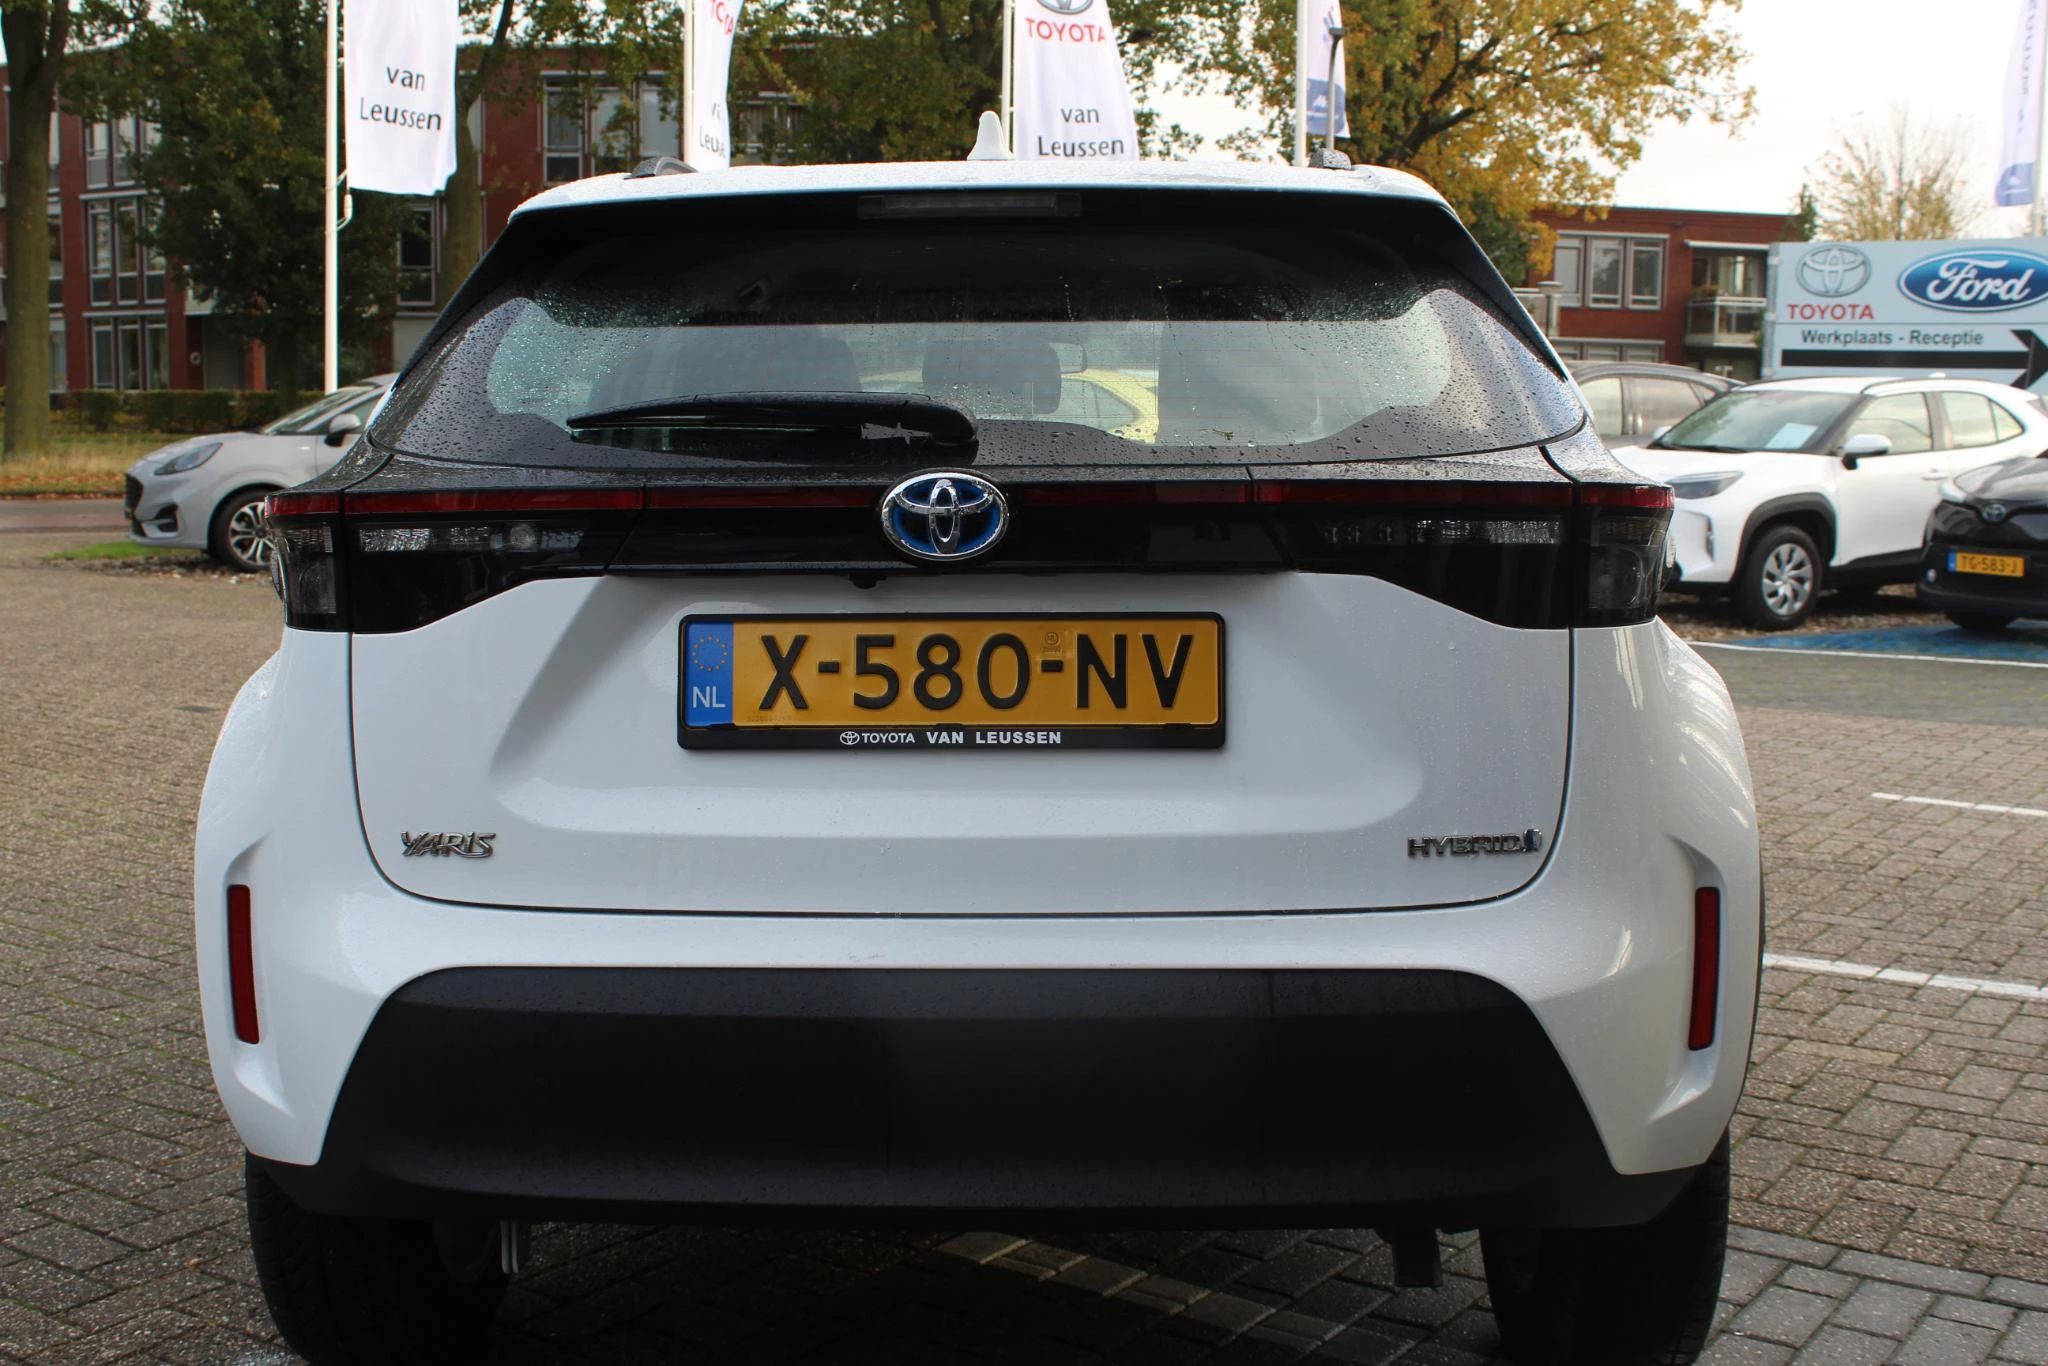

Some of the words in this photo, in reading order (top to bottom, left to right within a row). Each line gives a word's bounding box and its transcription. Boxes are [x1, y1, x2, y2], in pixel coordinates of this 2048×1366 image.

[386, 66, 425, 91] van
[360, 96, 442, 130] Leussen
[1061, 108, 1099, 123] van
[1038, 135, 1124, 157] Leussen
[1926, 258, 2036, 301] Ford
[1787, 303, 1875, 321] TOYOTA
[1801, 329, 1893, 349] Werkplaats
[1908, 329, 1984, 349] Receptie
[758, 633, 1194, 711] X-580-NV
[692, 686, 726, 709] NL
[861, 732, 916, 744] TOYOTA
[926, 731, 965, 744] VAN
[975, 731, 1062, 744] LEUSSEN
[401, 831, 497, 859] YARIS
[1407, 834, 1521, 857] HYBRID
